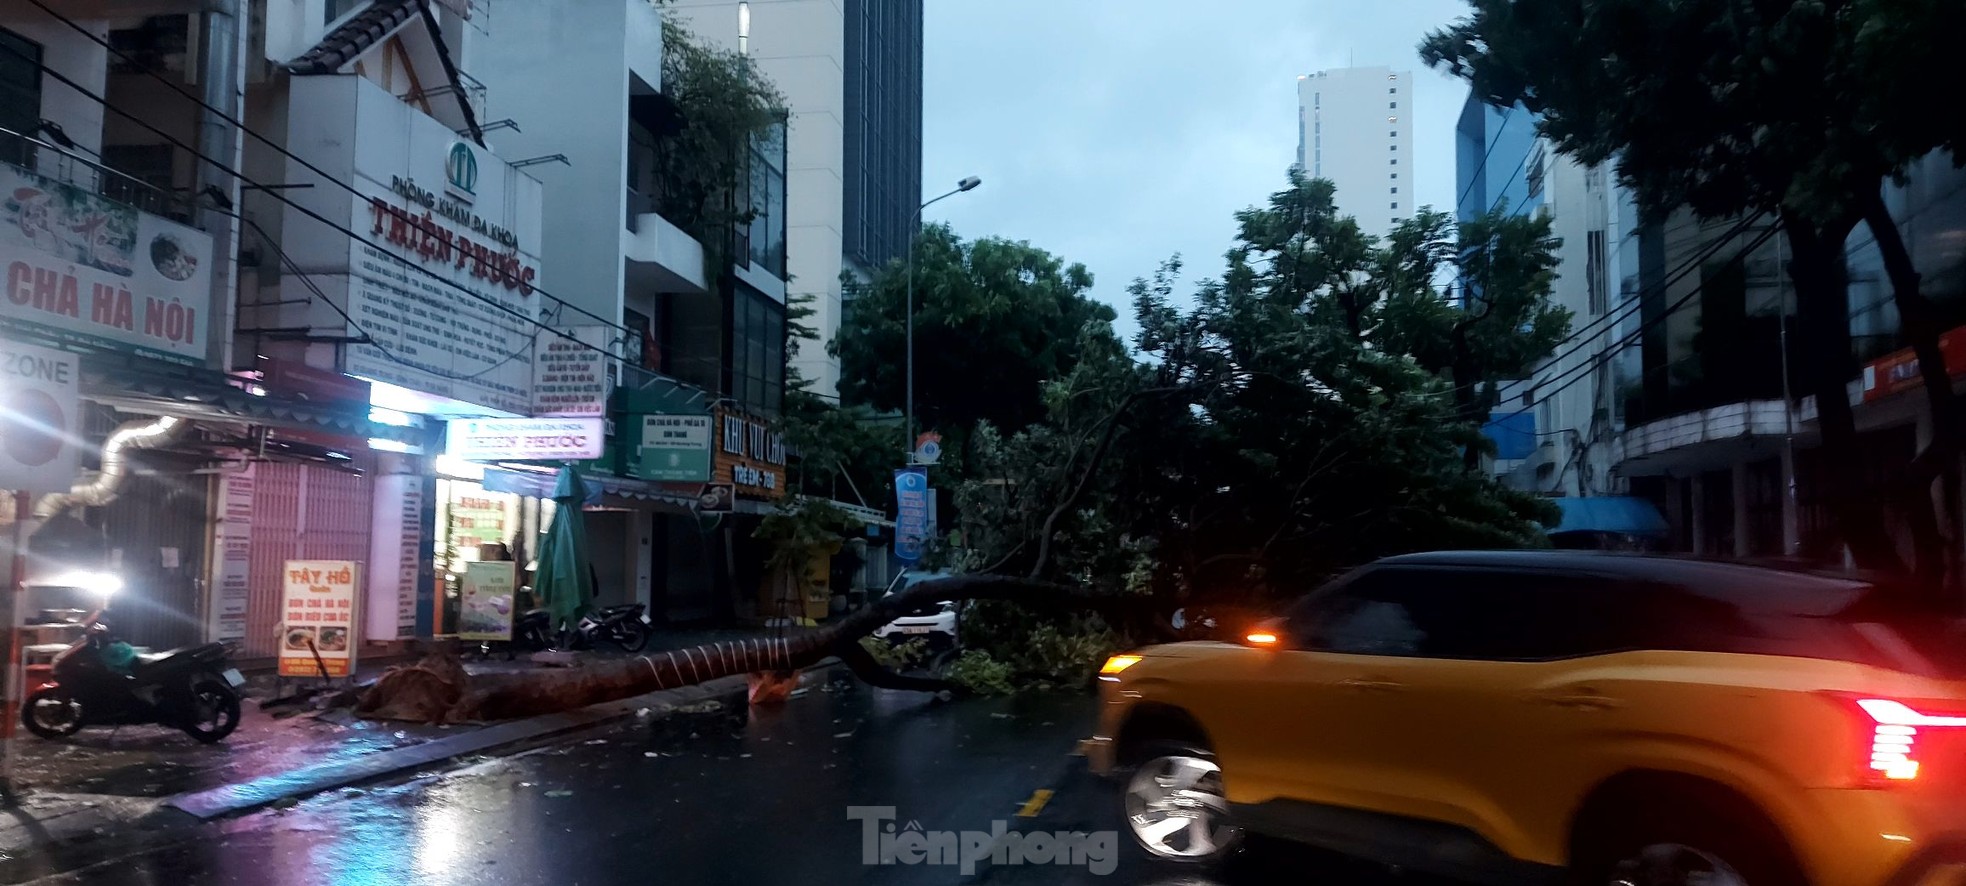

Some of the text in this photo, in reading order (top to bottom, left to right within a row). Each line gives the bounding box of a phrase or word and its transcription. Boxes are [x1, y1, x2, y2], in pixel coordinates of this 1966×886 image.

[490, 223, 519, 250] KHOA
[6, 260, 80, 318] CHẢ
[91, 282, 134, 332] HÀ
[144, 296, 195, 348] NỘI
[723, 414, 745, 456] KHU
[749, 422, 765, 462] VUI
[289, 567, 322, 585] TÂY
